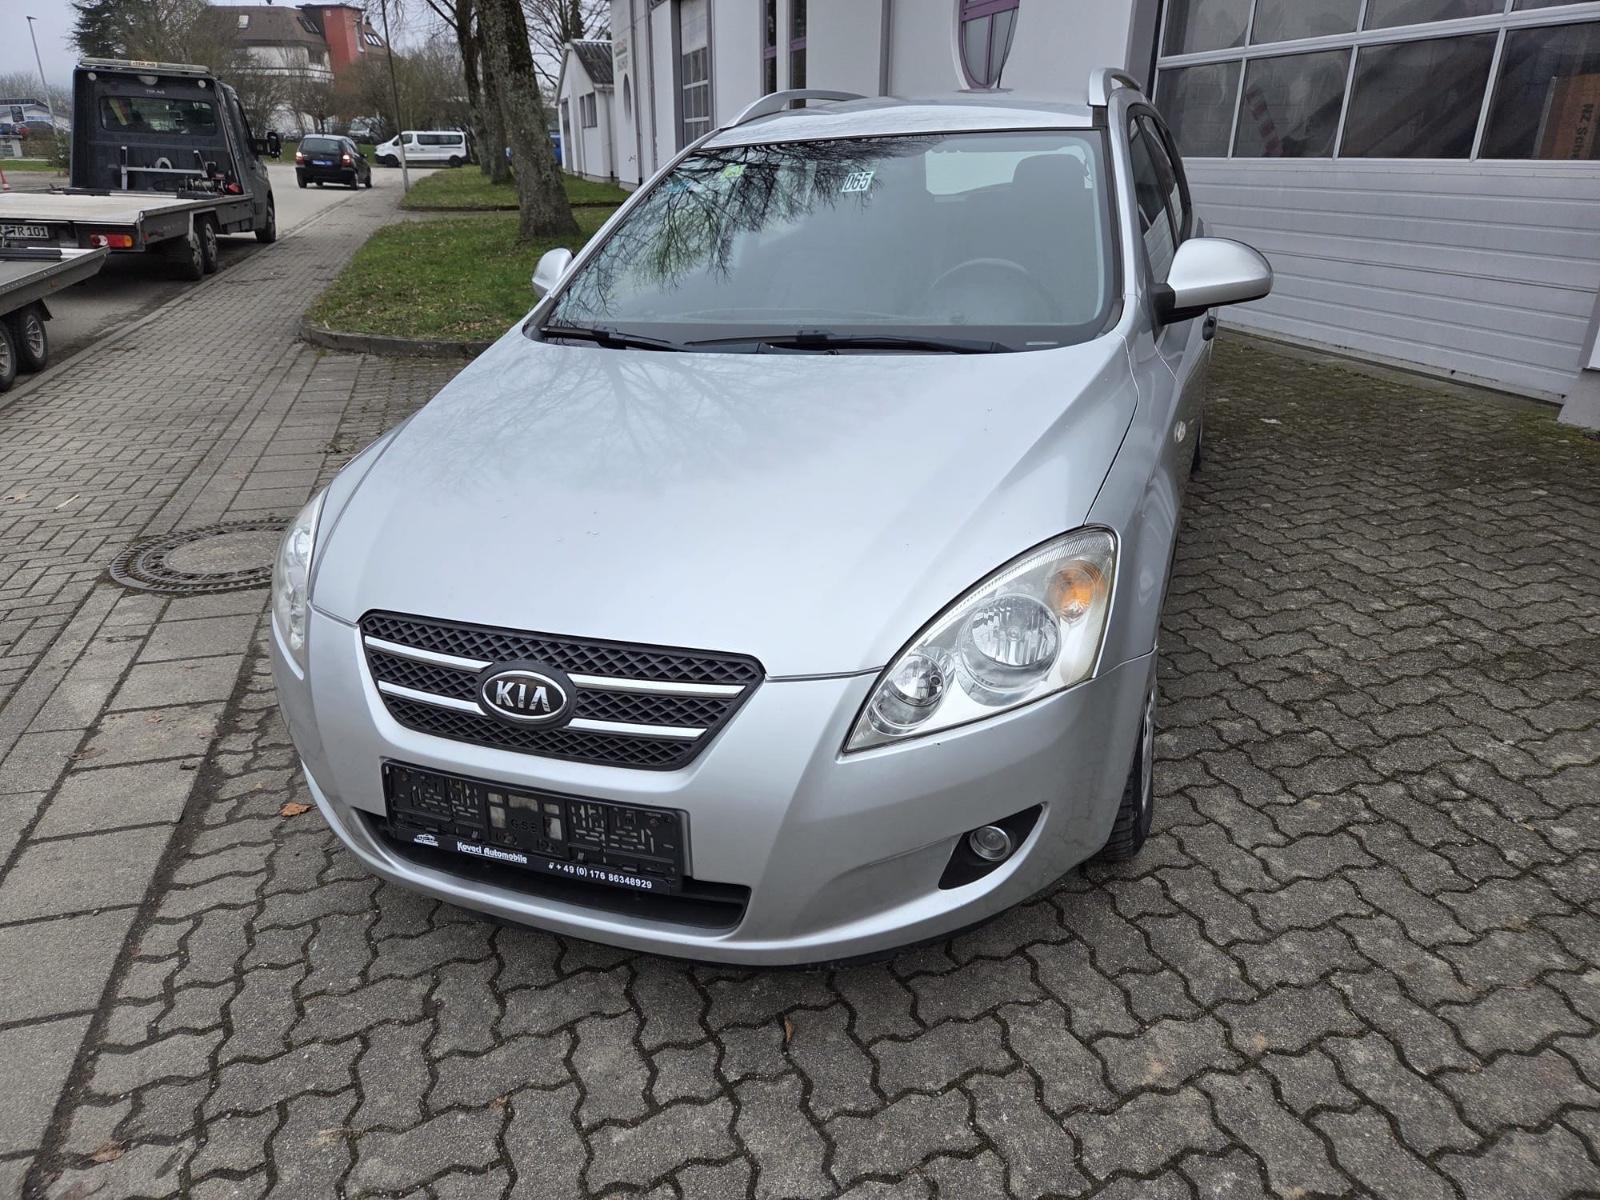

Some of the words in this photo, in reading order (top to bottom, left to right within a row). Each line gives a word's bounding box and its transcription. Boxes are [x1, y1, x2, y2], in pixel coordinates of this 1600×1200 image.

[844, 172, 872, 190] 065
[26, 226, 48, 237] 101
[495, 680, 551, 712] KIA
[483, 847, 528, 864] Automobile
[563, 864, 575, 874] 49
[576, 865, 588, 877] (0)
[589, 869, 606, 880] 176
[608, 873, 653, 889] 86348929
